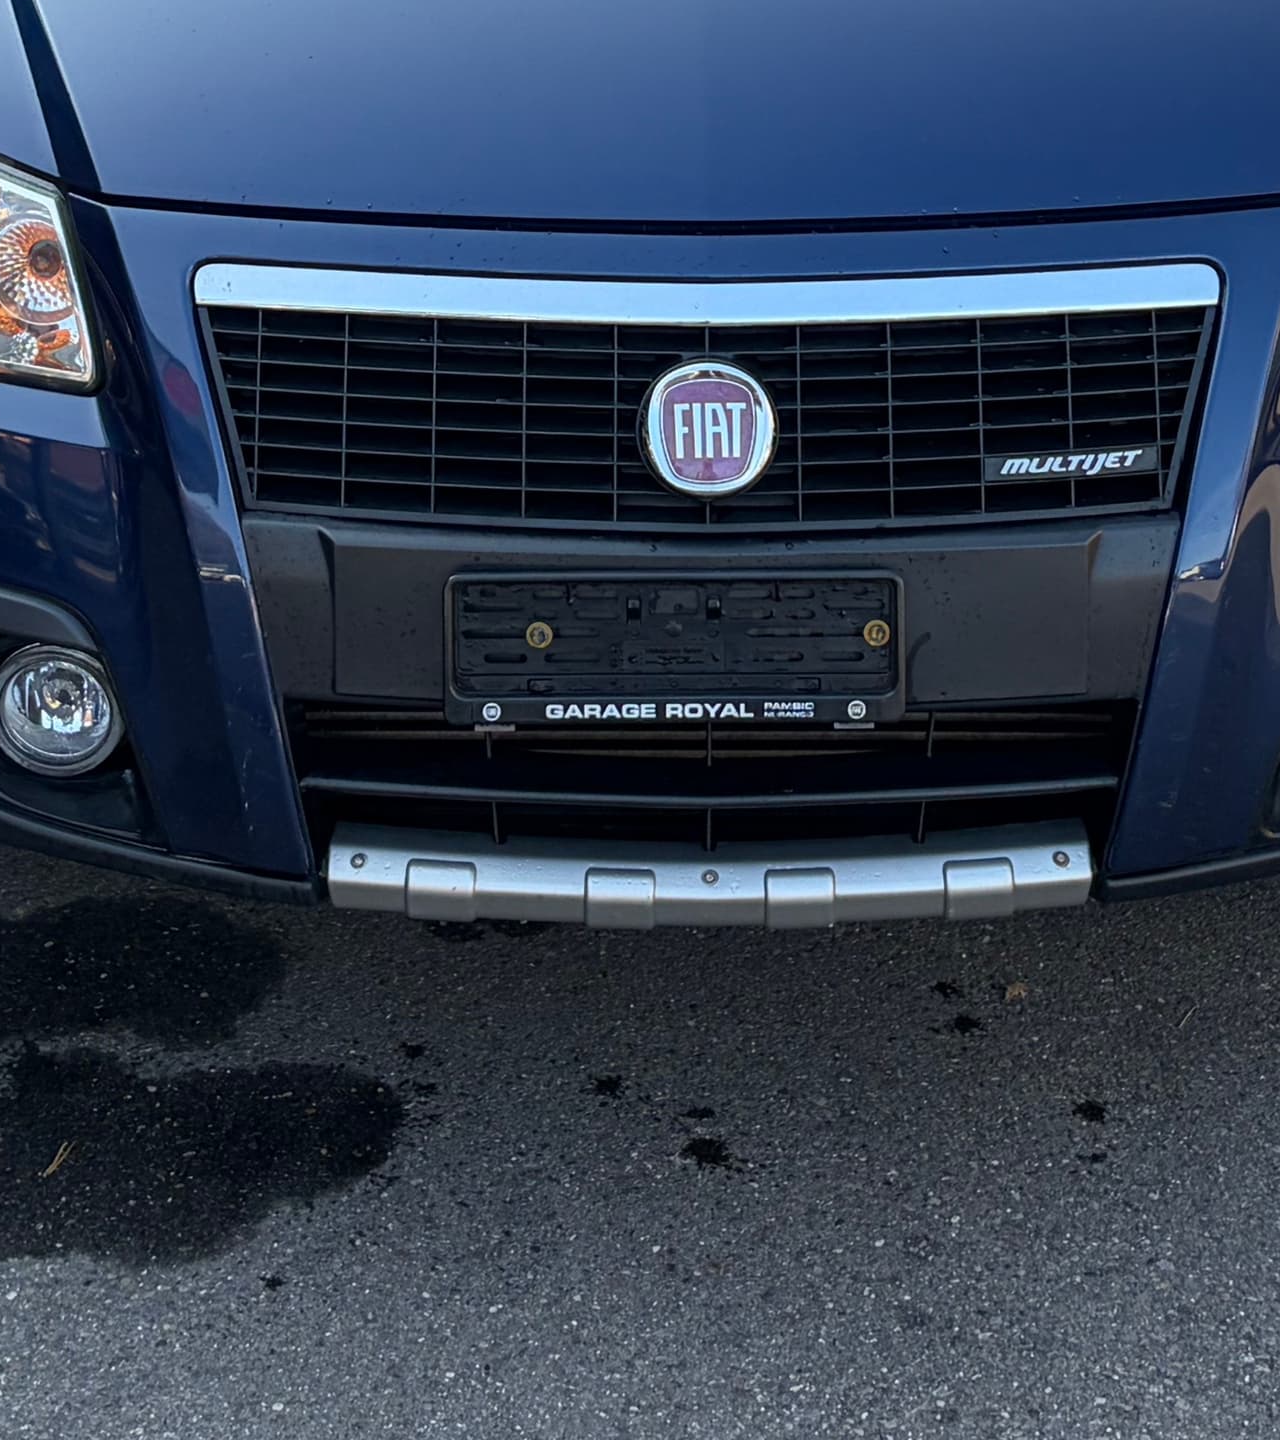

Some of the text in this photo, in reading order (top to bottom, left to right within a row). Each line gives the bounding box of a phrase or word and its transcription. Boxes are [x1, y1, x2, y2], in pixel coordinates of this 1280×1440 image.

[673, 401, 747, 459] FIAT
[999, 449, 1143, 476] MULTIJET
[545, 702, 755, 719] GARAGE ROYAL
